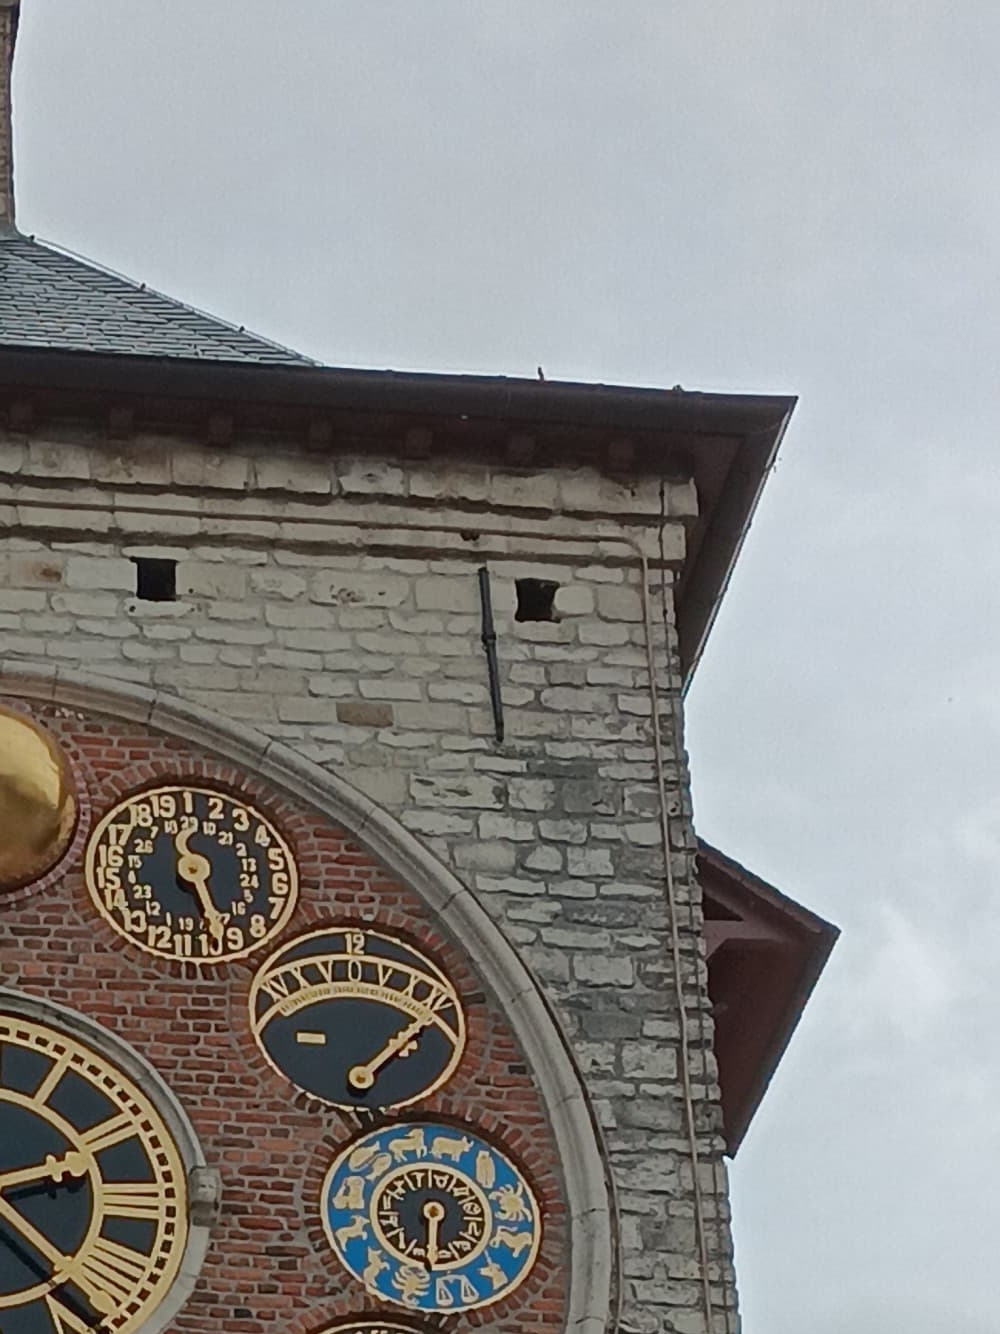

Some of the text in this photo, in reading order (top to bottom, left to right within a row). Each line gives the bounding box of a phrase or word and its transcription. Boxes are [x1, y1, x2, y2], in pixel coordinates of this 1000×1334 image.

[150, 796, 175, 817] 19
[183, 792, 193, 813] 1
[209, 799, 224, 819] 2
[129, 804, 152, 827] 18
[233, 809, 249, 831] 3
[108, 824, 131, 845] 17
[219, 832, 233, 845] 21
[256, 825, 270, 847] 4
[100, 845, 123, 866] 16
[236, 844, 247, 856] 2
[268, 848, 284, 870] 5
[97, 868, 121, 889] 15
[240, 874, 259, 888] 24
[272, 873, 288, 894] 6
[105, 889, 128, 910] 14
[133, 885, 151, 899] 23
[146, 902, 160, 916] 12
[269, 897, 285, 919] 7
[124, 911, 146, 932] 13
[250, 915, 266, 937] 8
[148, 926, 171, 948] 12
[174, 934, 192, 956] 11
[227, 928, 243, 950] 9
[345, 933, 365, 955] 12
[317, 960, 333, 983] V
[378, 963, 392, 986] V
[31, 1053, 74, 1103] I
[80, 1111, 136, 1153] II
[101, 1182, 161, 1219] III
